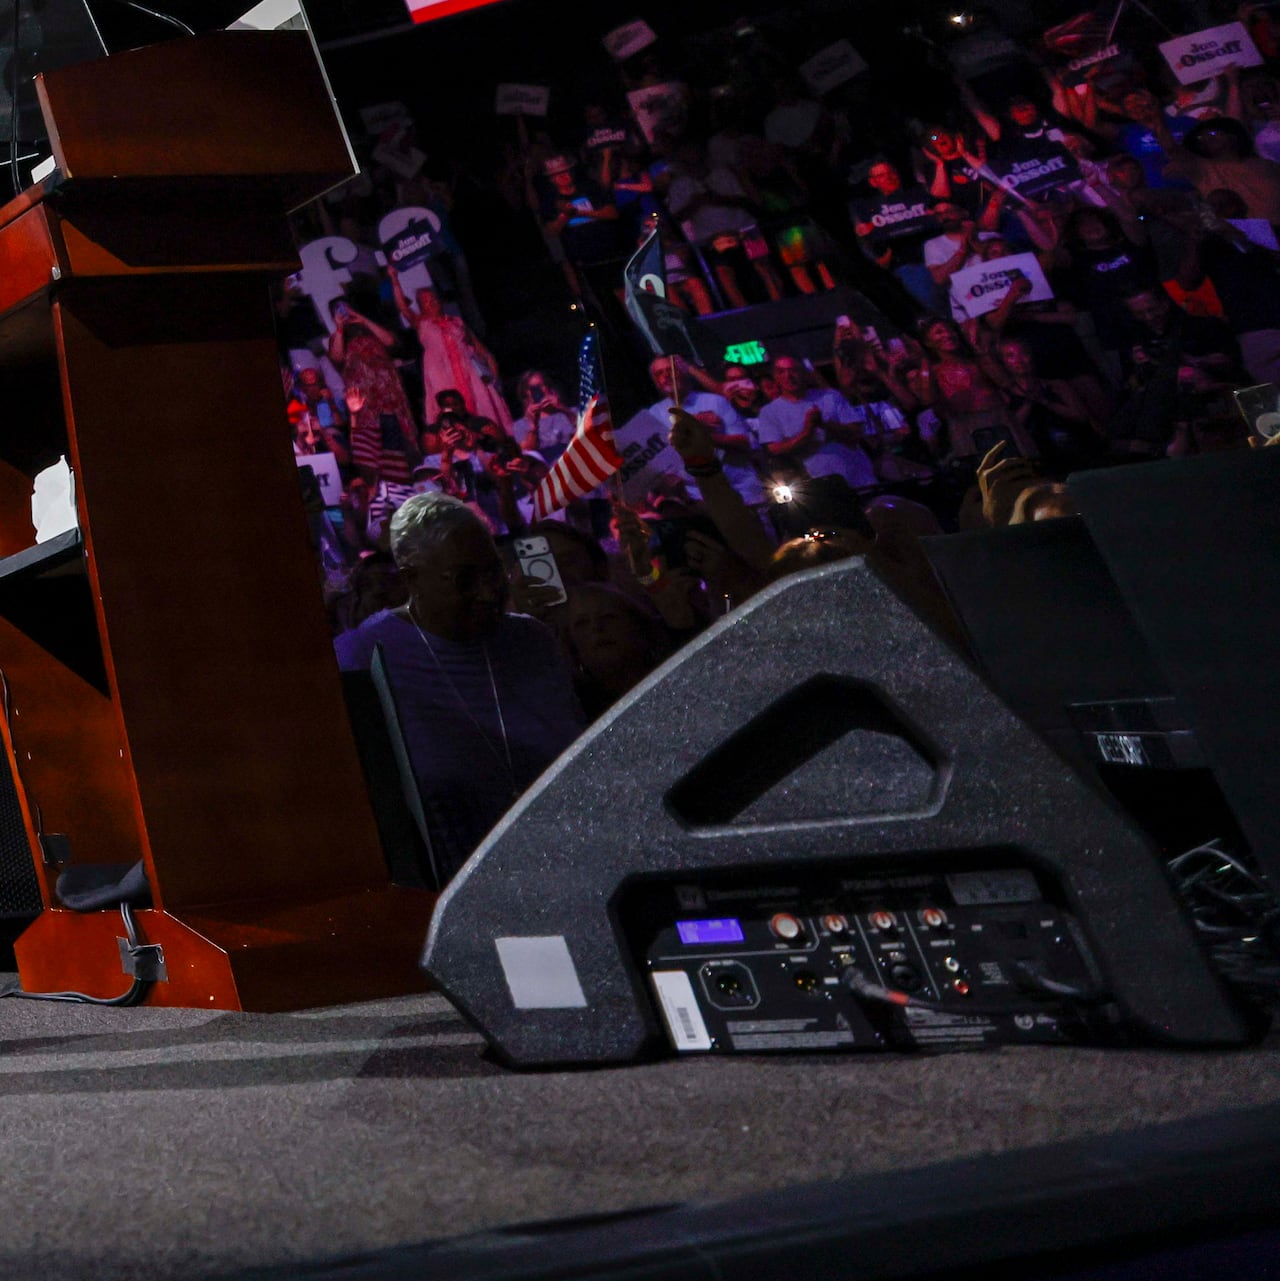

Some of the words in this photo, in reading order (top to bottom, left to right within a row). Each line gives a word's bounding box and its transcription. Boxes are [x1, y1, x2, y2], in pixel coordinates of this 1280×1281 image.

[1179, 40, 1242, 67] Ossoff
[1191, 40, 1217, 52] Jon
[1002, 155, 1067, 186] Ossoff
[1012, 158, 1041, 174] Jon
[872, 203, 926, 228] Ossoff
[881, 203, 906, 215] Jon
